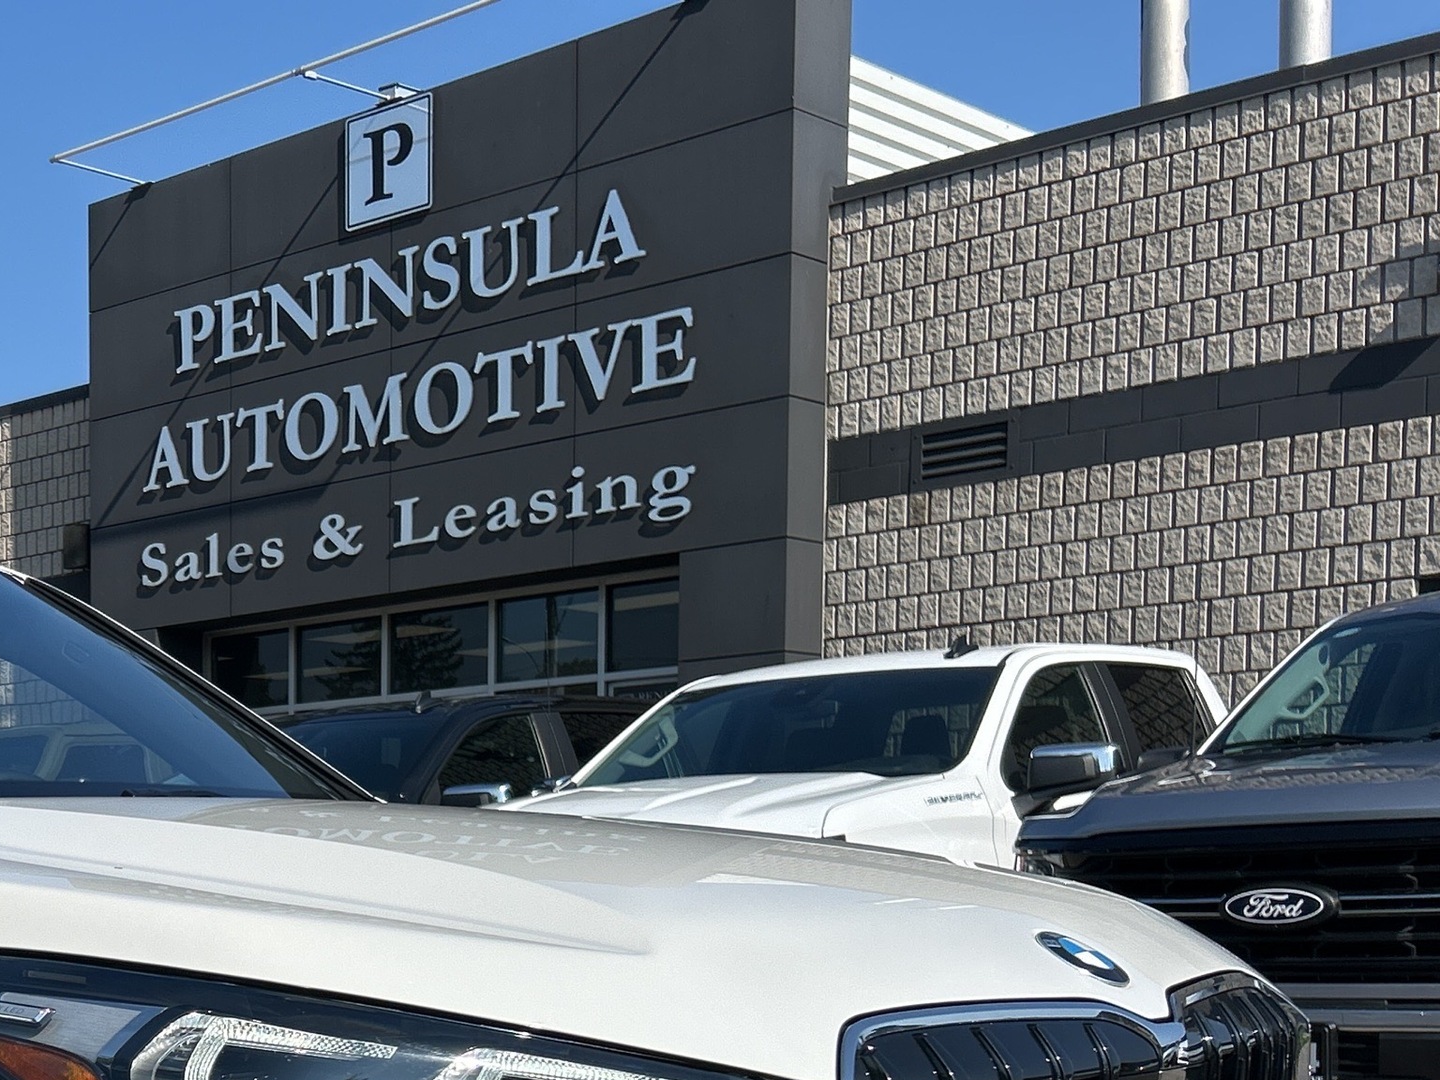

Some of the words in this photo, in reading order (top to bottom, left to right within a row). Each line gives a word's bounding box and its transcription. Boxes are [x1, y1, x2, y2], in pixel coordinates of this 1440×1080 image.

[363, 121, 413, 206] P
[174, 189, 646, 374] PENINSULA
[143, 306, 696, 493] AUTOMOTIVE
[141, 532, 284, 587] Sales
[313, 514, 363, 562] &
[393, 464, 696, 549] Leasing
[1243, 893, 1304, 918] Ford
